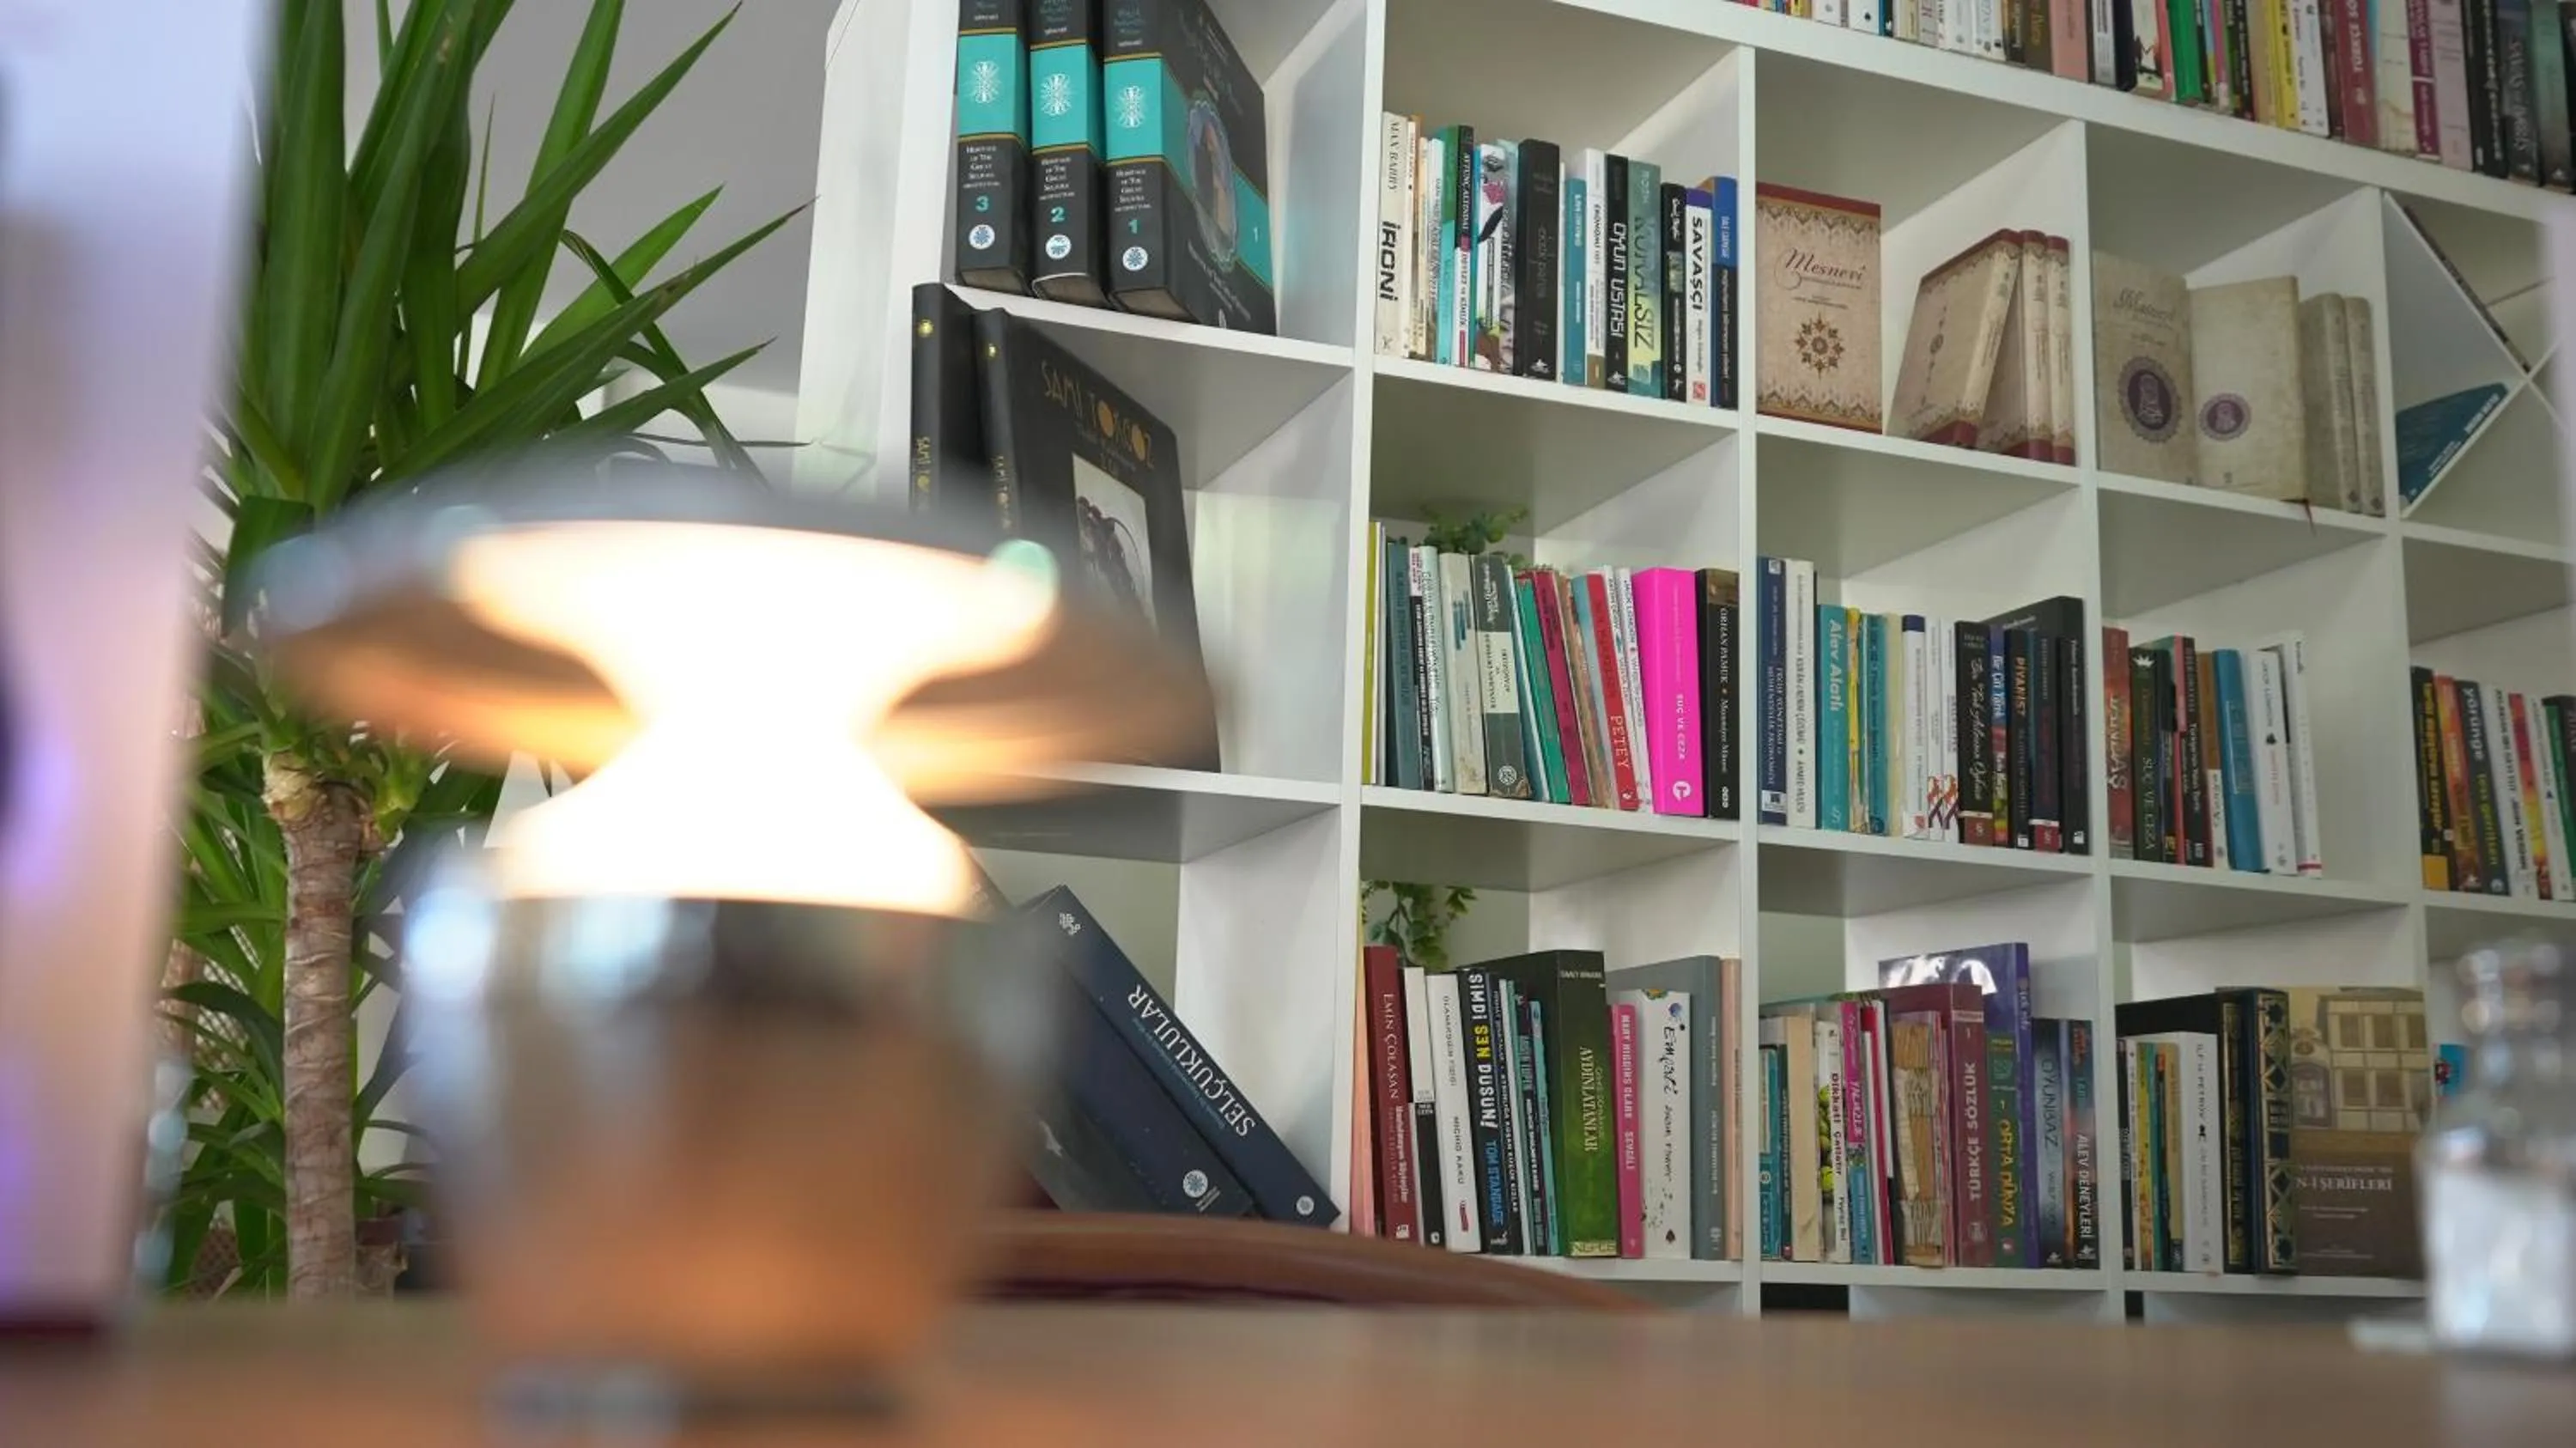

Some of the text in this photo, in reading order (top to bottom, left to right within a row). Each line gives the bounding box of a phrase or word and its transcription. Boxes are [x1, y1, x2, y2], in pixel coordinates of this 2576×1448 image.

[1387, 120, 1400, 192] MAX BARRY
[975, 195, 989, 211] 3
[1050, 206, 1066, 222] 2
[1127, 219, 1138, 234] 1
[1380, 220, 1401, 302] İRONİ
[1608, 222, 1626, 338] OYUN USTASI
[1634, 216, 1657, 351] KURALSIZ
[1690, 216, 1704, 311] SAVAŞÇI
[1781, 247, 1867, 284] Mesnevi
[1720, 607, 1728, 648] ORHAN
[1720, 648, 1729, 684] PAMUK
[1829, 619, 1844, 712] Alev Alatlı
[2015, 656, 2026, 716] PİYANİST
[1611, 715, 1630, 769] PETEY
[1677, 733, 1686, 760] CEZA
[2462, 687, 2484, 762] yörünge
[2144, 787, 2154, 806] VE
[2145, 812, 2155, 850] CEZA
[1127, 983, 1256, 1137] SELÇUKLULAR
[1579, 1046, 1598, 1153] AYDINLATANLAR
[1965, 1062, 1982, 1201] TÜRKÇE SÖZLÜK
[2041, 1058, 2059, 1149] OYUNBAZ
[1455, 1154, 1465, 1185] KAKU
[1485, 1140, 1504, 1226] TOM STANDAGE
[1998, 1119, 2016, 1227] ORTA DÜNYA
[2076, 1134, 2093, 1238] ALEV DENEYLERİ
